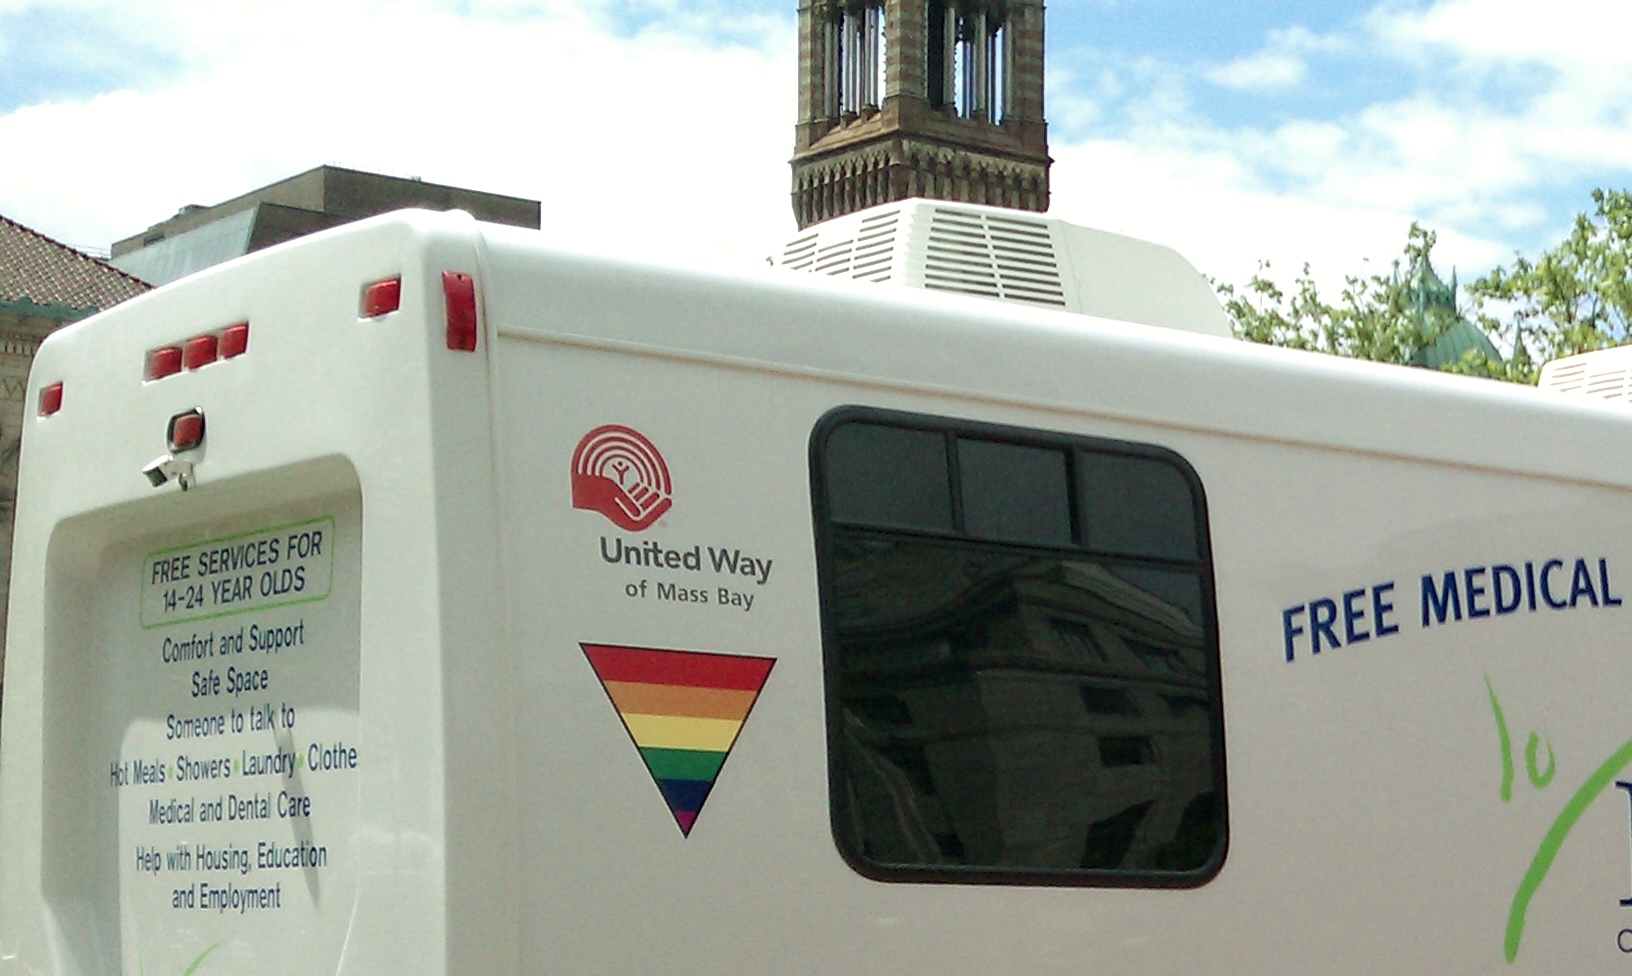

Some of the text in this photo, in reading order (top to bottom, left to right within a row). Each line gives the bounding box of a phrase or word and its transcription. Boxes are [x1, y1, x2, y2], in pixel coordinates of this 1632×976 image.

[151, 530, 322, 585] FREE SERVICES FOR
[600, 536, 773, 585] United Way
[162, 565, 306, 613] 14-24 YEAR OLDS
[625, 579, 754, 612] of Mass Bay
[1281, 581, 1400, 663] FREE
[1420, 557, 1623, 628] MEDICAL
[162, 618, 304, 664] Comfort and Support
[191, 666, 269, 698] Safe Space
[166, 701, 296, 741] Someone to talk to
[110, 762, 129, 787] Hot
[133, 758, 166, 784] Meals
[176, 755, 231, 782] Showers
[242, 747, 296, 779] Laundry
[149, 790, 311, 825] Medical and Dental Care
[136, 841, 328, 876] Help with Housing, Education
[172, 882, 282, 914] and Employment
